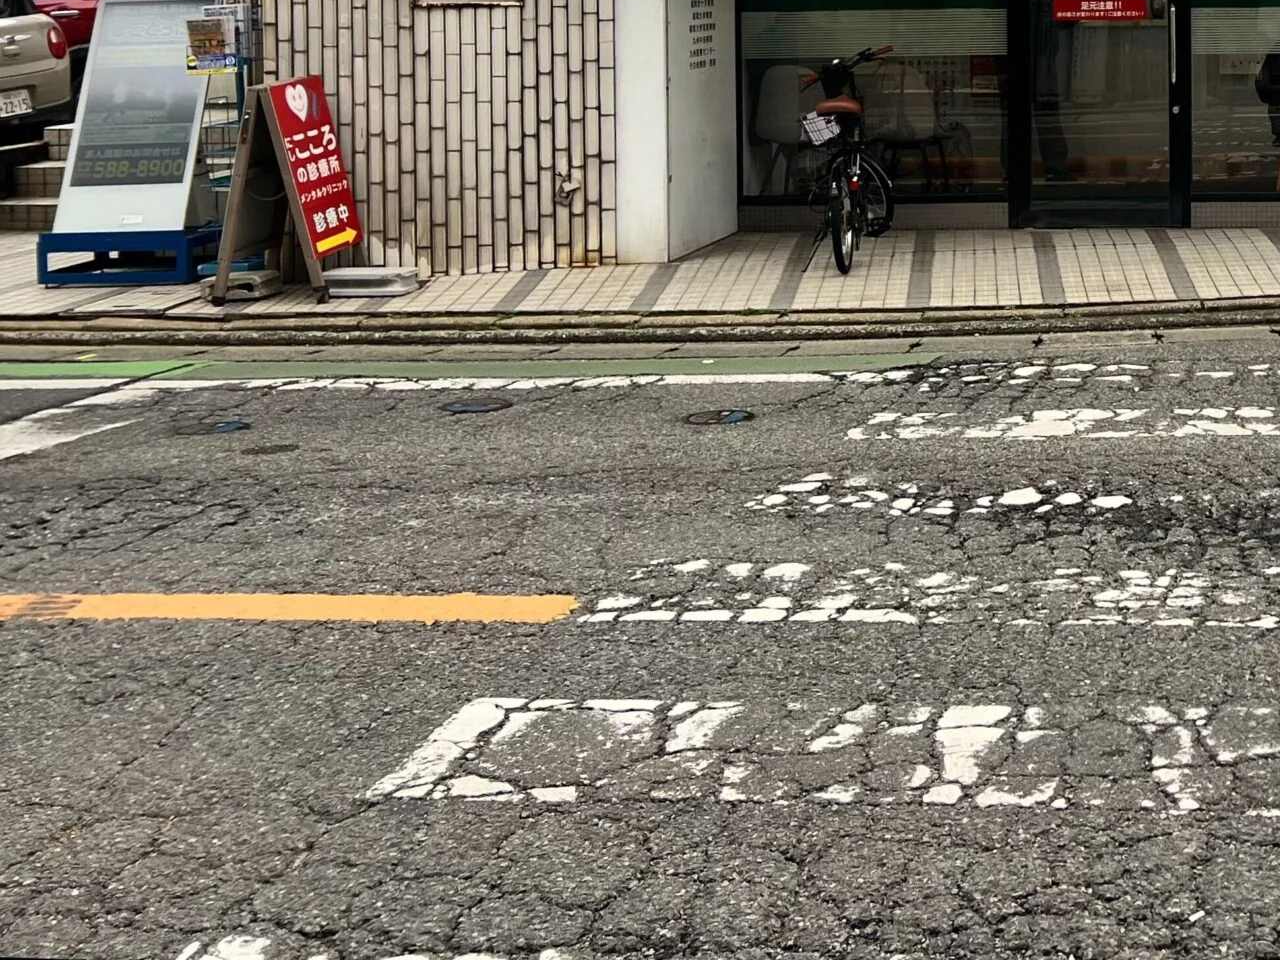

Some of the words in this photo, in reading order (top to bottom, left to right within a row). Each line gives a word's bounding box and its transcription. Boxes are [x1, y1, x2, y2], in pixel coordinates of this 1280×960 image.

[293, 124, 337, 159] こころ
[92, 158, 185, 179] 588-8900
[297, 155, 341, 183] の診療所
[300, 179, 348, 204] メンタルクリニック
[313, 203, 350, 233] 診療中
